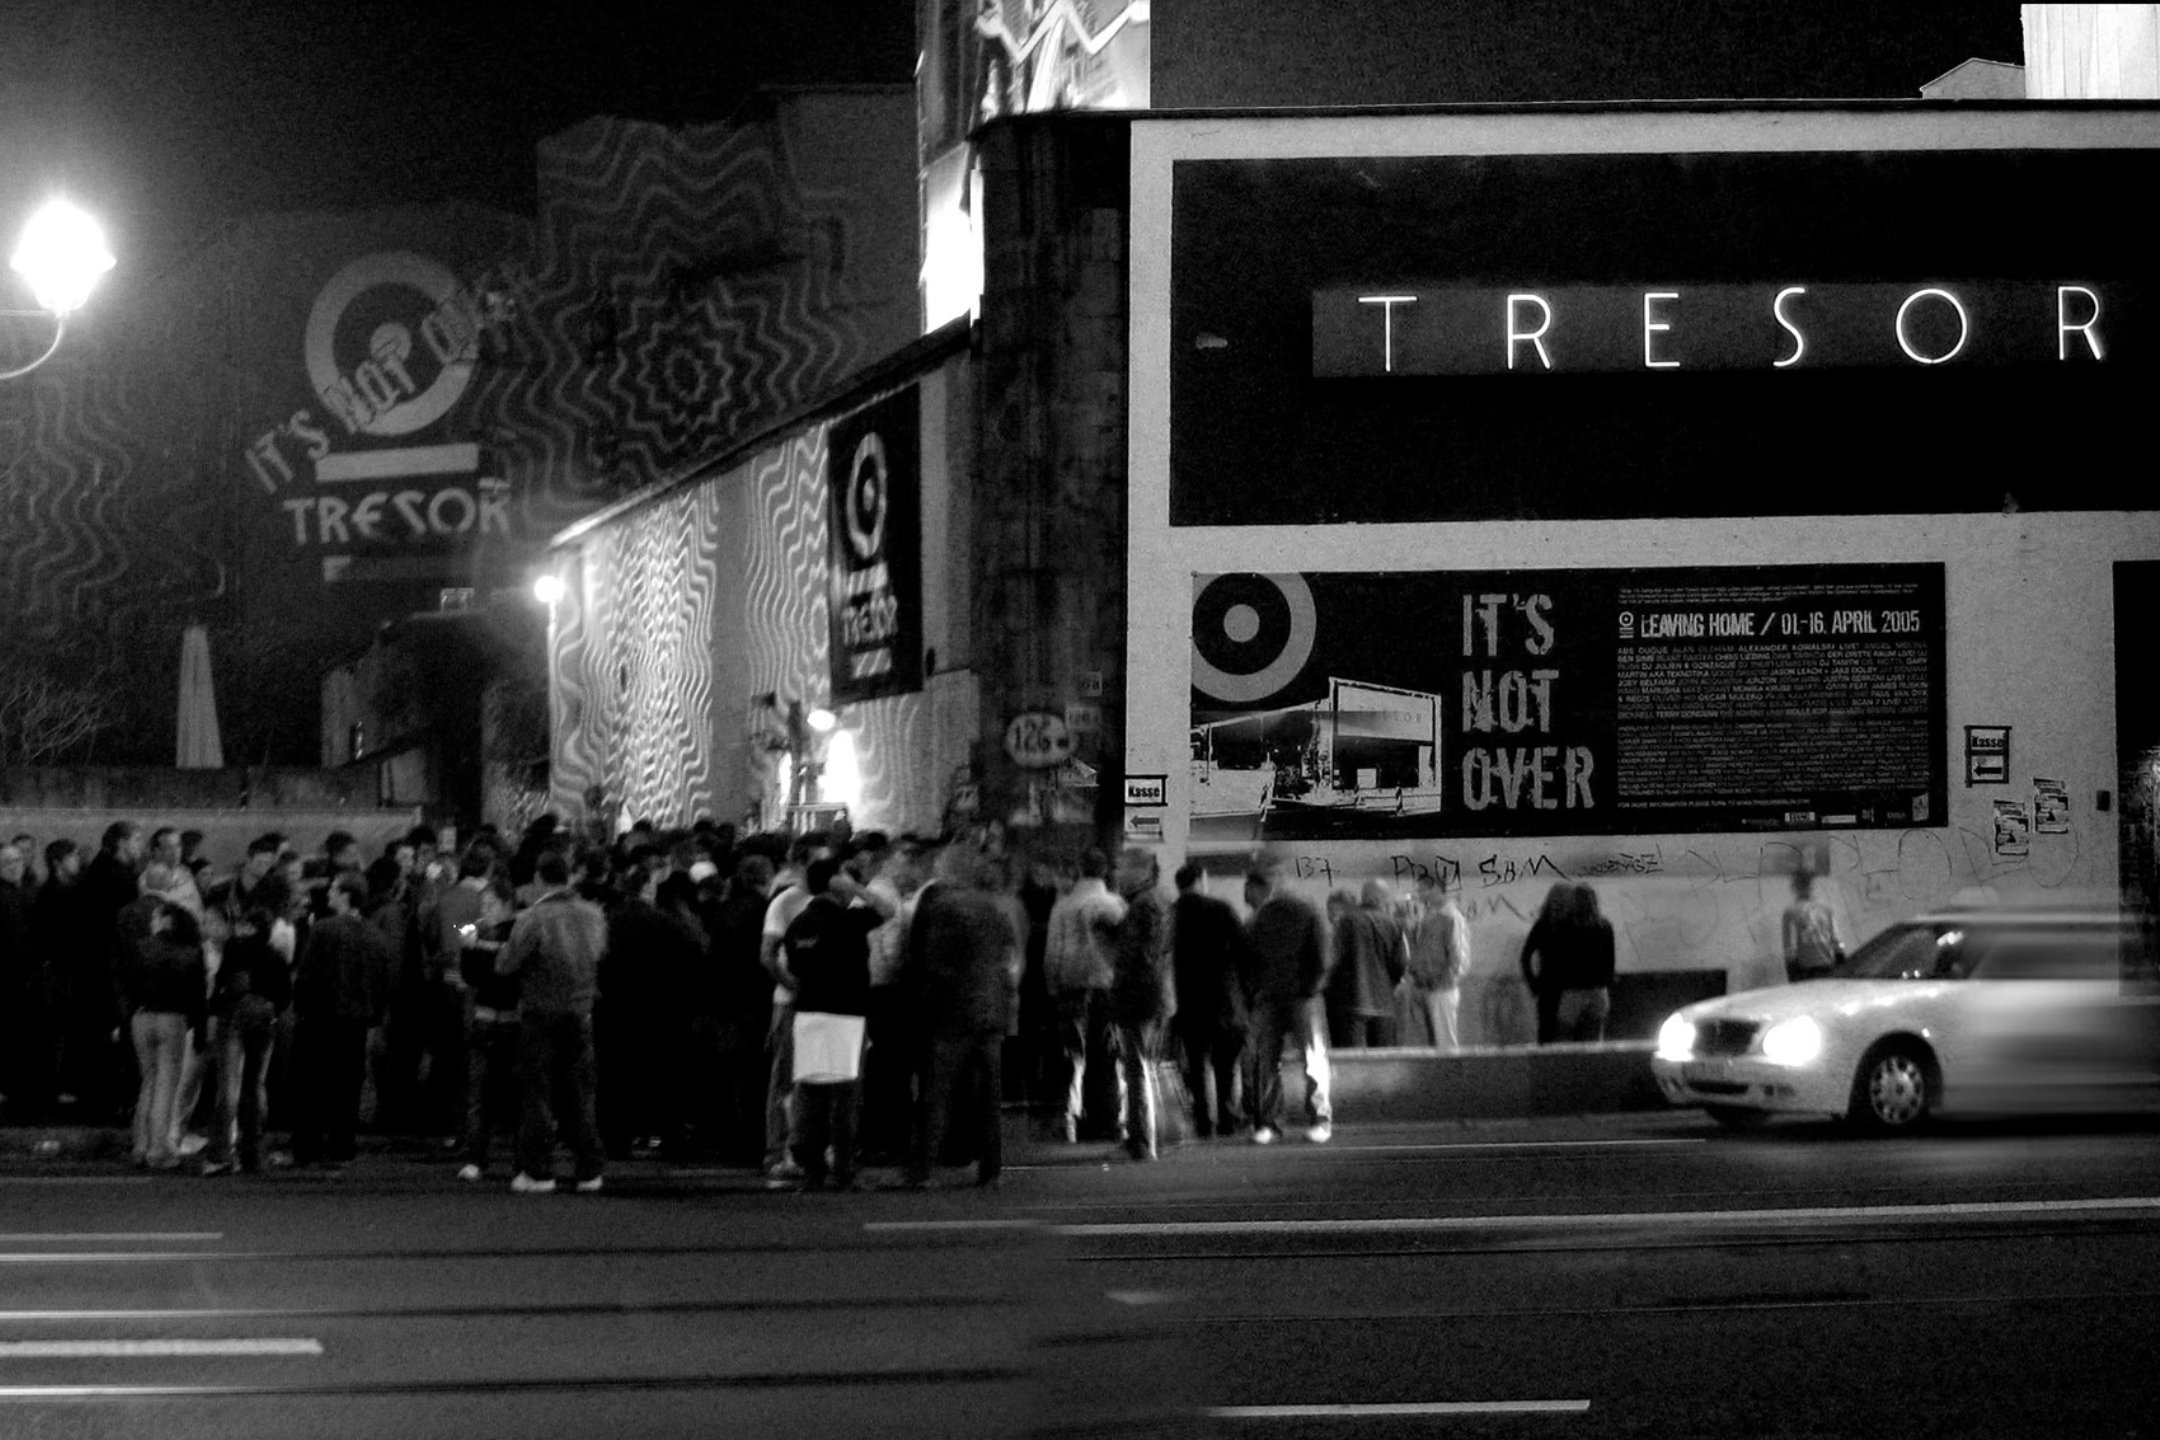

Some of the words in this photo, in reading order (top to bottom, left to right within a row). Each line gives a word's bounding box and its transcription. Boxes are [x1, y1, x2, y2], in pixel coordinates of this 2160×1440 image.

[1357, 285, 2102, 372] TRESOR
[246, 409, 330, 495] IT'S
[283, 477, 512, 546] TRESOR
[1461, 593, 1555, 657] IT'S
[1641, 612, 1705, 639] LEAVING
[1708, 611, 1755, 637] HOME
[1831, 609, 1877, 634] APRIL
[1881, 608, 1921, 633] 2005
[1461, 669, 1560, 734] NOT
[1128, 784, 1161, 799] Kasse
[1461, 746, 1596, 812] OVER
